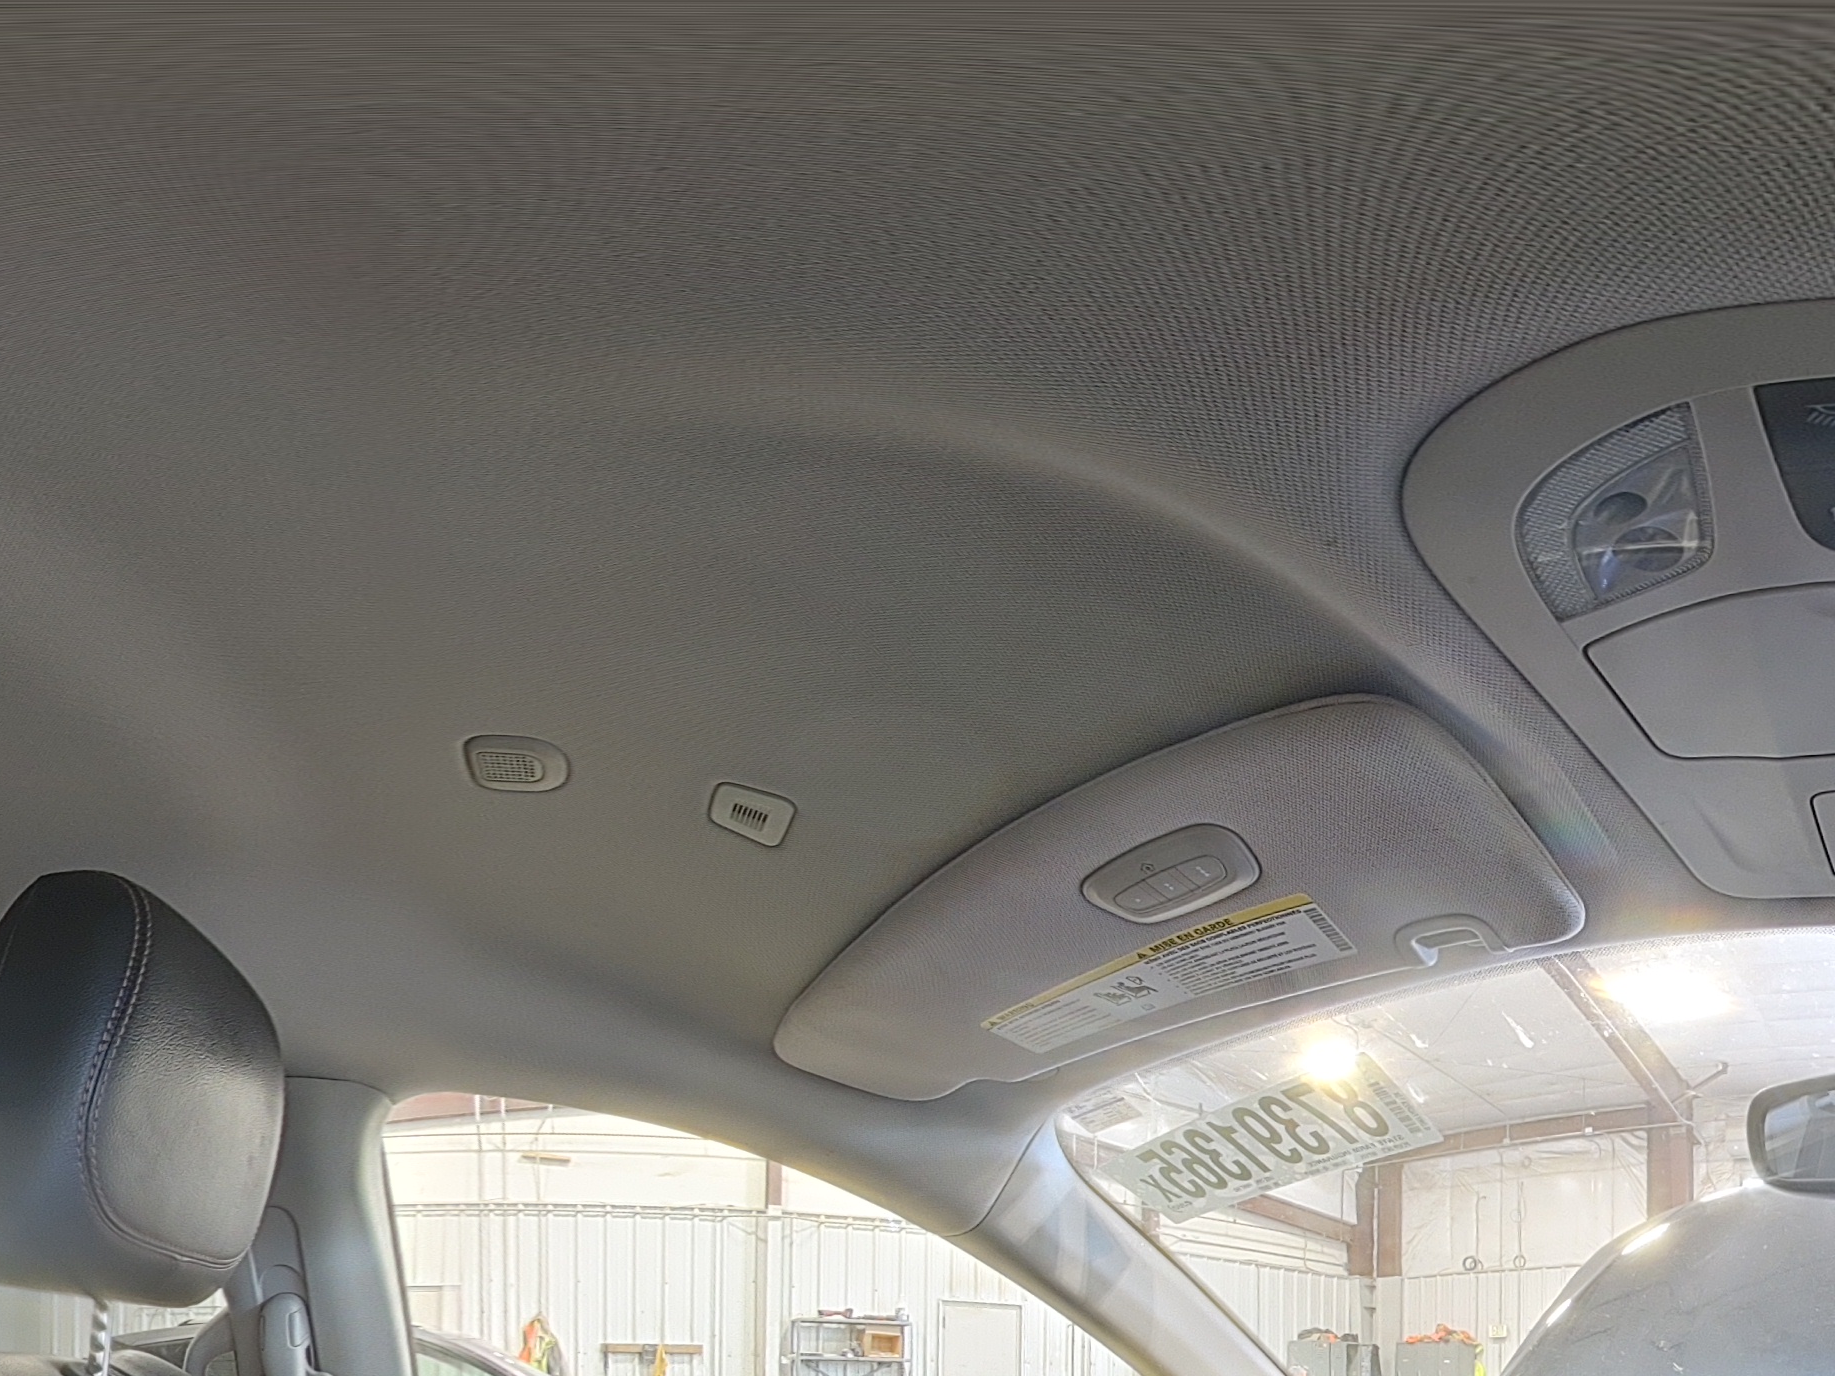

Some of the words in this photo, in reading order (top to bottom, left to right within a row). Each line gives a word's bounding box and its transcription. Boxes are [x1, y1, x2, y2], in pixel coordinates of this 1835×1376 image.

[1149, 937, 1177, 954] MISE
[1177, 931, 1194, 943] EN
[1195, 918, 1235, 937] GARDE
